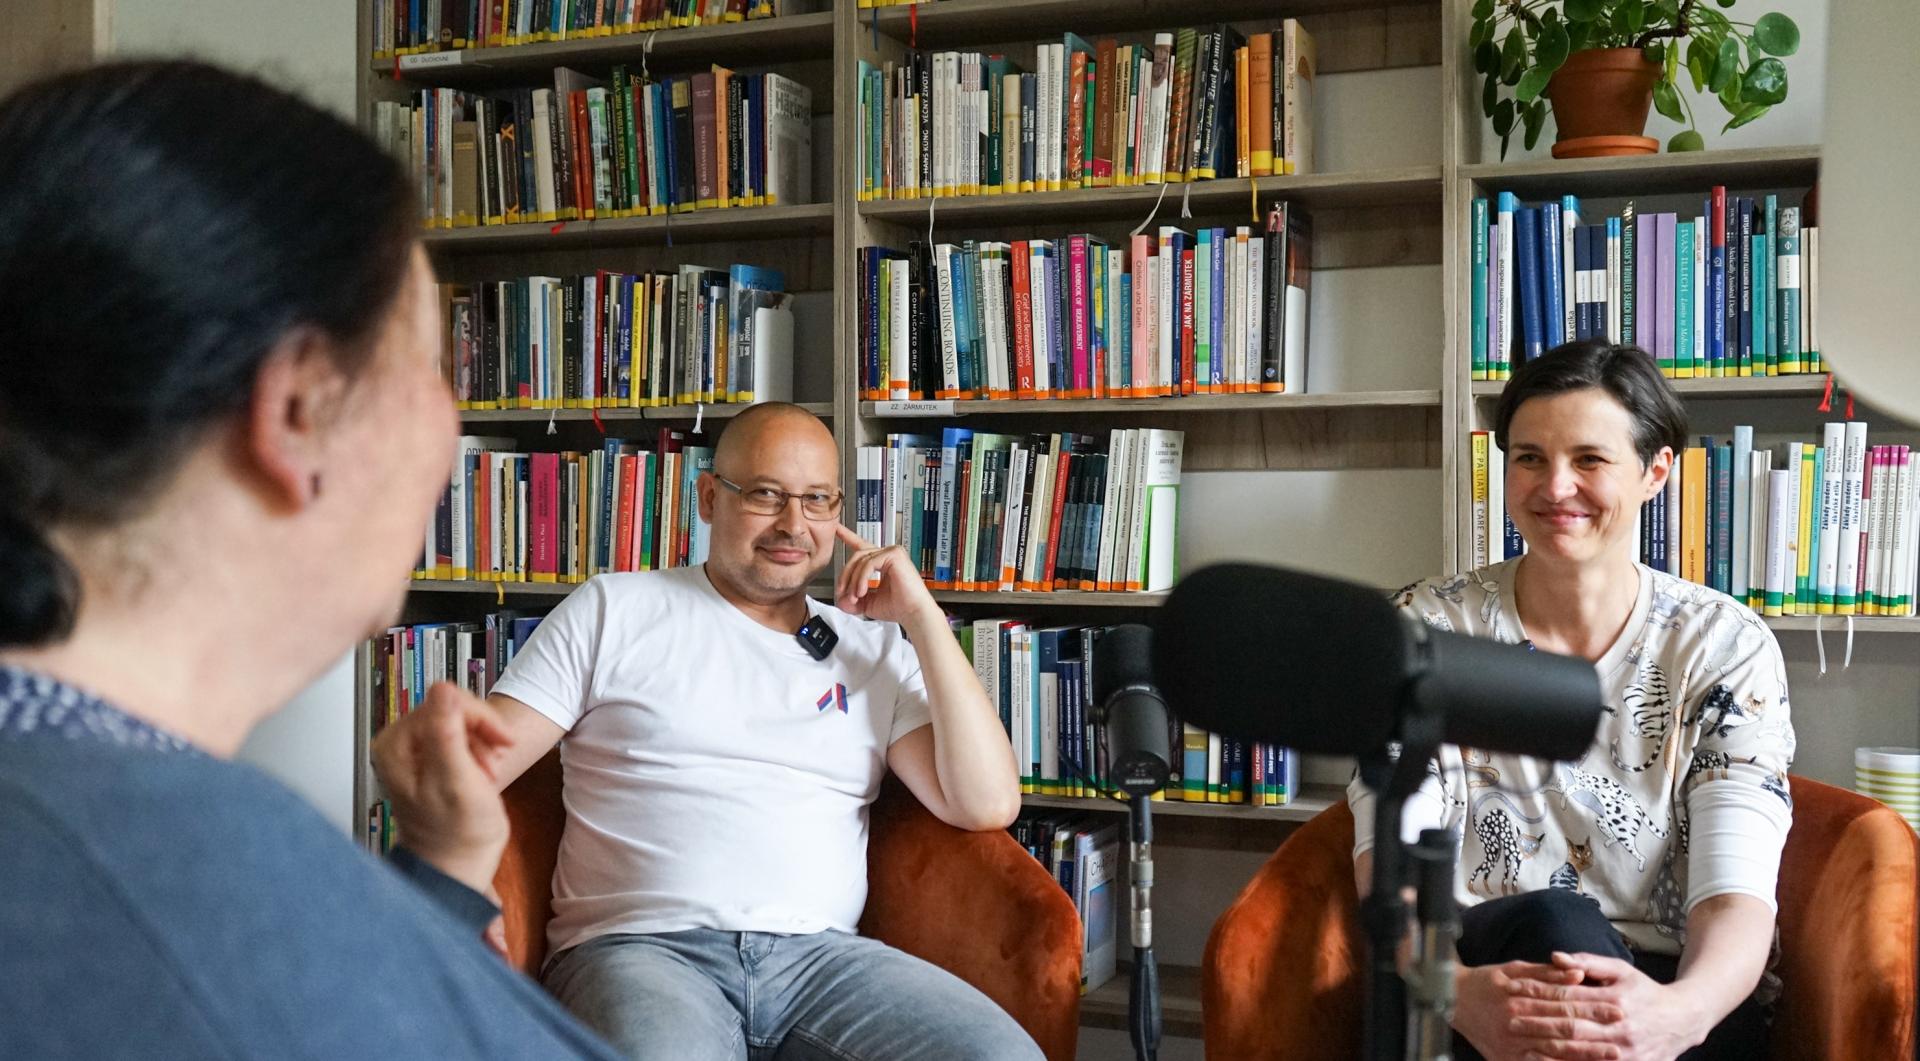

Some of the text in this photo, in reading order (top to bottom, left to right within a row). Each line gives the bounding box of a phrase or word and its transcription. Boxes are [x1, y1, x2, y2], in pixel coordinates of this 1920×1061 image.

[1207, 32, 1222, 100] Život po smrti
[921, 71, 929, 98] ŽIVOT?
[1624, 228, 1633, 264] LIBERALISM'S
[1681, 229, 1689, 292] IVAN ILLICH
[1728, 246, 1736, 274] Medically
[1135, 260, 1143, 289] Children
[1624, 265, 1632, 292] TROUBLED
[1074, 263, 1083, 351] HANDBOOK OF BEREAVEMENT
[1183, 259, 1192, 329] JAK NA ZÁRMUTEK
[1624, 293, 1632, 314] SEARCH
[939, 269, 955, 376] CONTINUING BONDS
[976, 303, 985, 338] Handbook
[1015, 300, 1023, 344] Contemporary
[1624, 314, 1632, 325] FOR
[903, 403, 937, 411] ZÁRMUTEK
[1833, 480, 1841, 496] etiky
[1853, 480, 1861, 496] etiky
[1476, 457, 1485, 567] PALLIATIVE CARE AND ET
[1823, 506, 1831, 530] Základy
[1843, 506, 1851, 530] Základy
[1020, 517, 1029, 546] WIDOWER'S
[1017, 547, 1026, 571] JOURNEY
[977, 628, 985, 677] BIOETHICS
[986, 637, 994, 694] COMPANION
